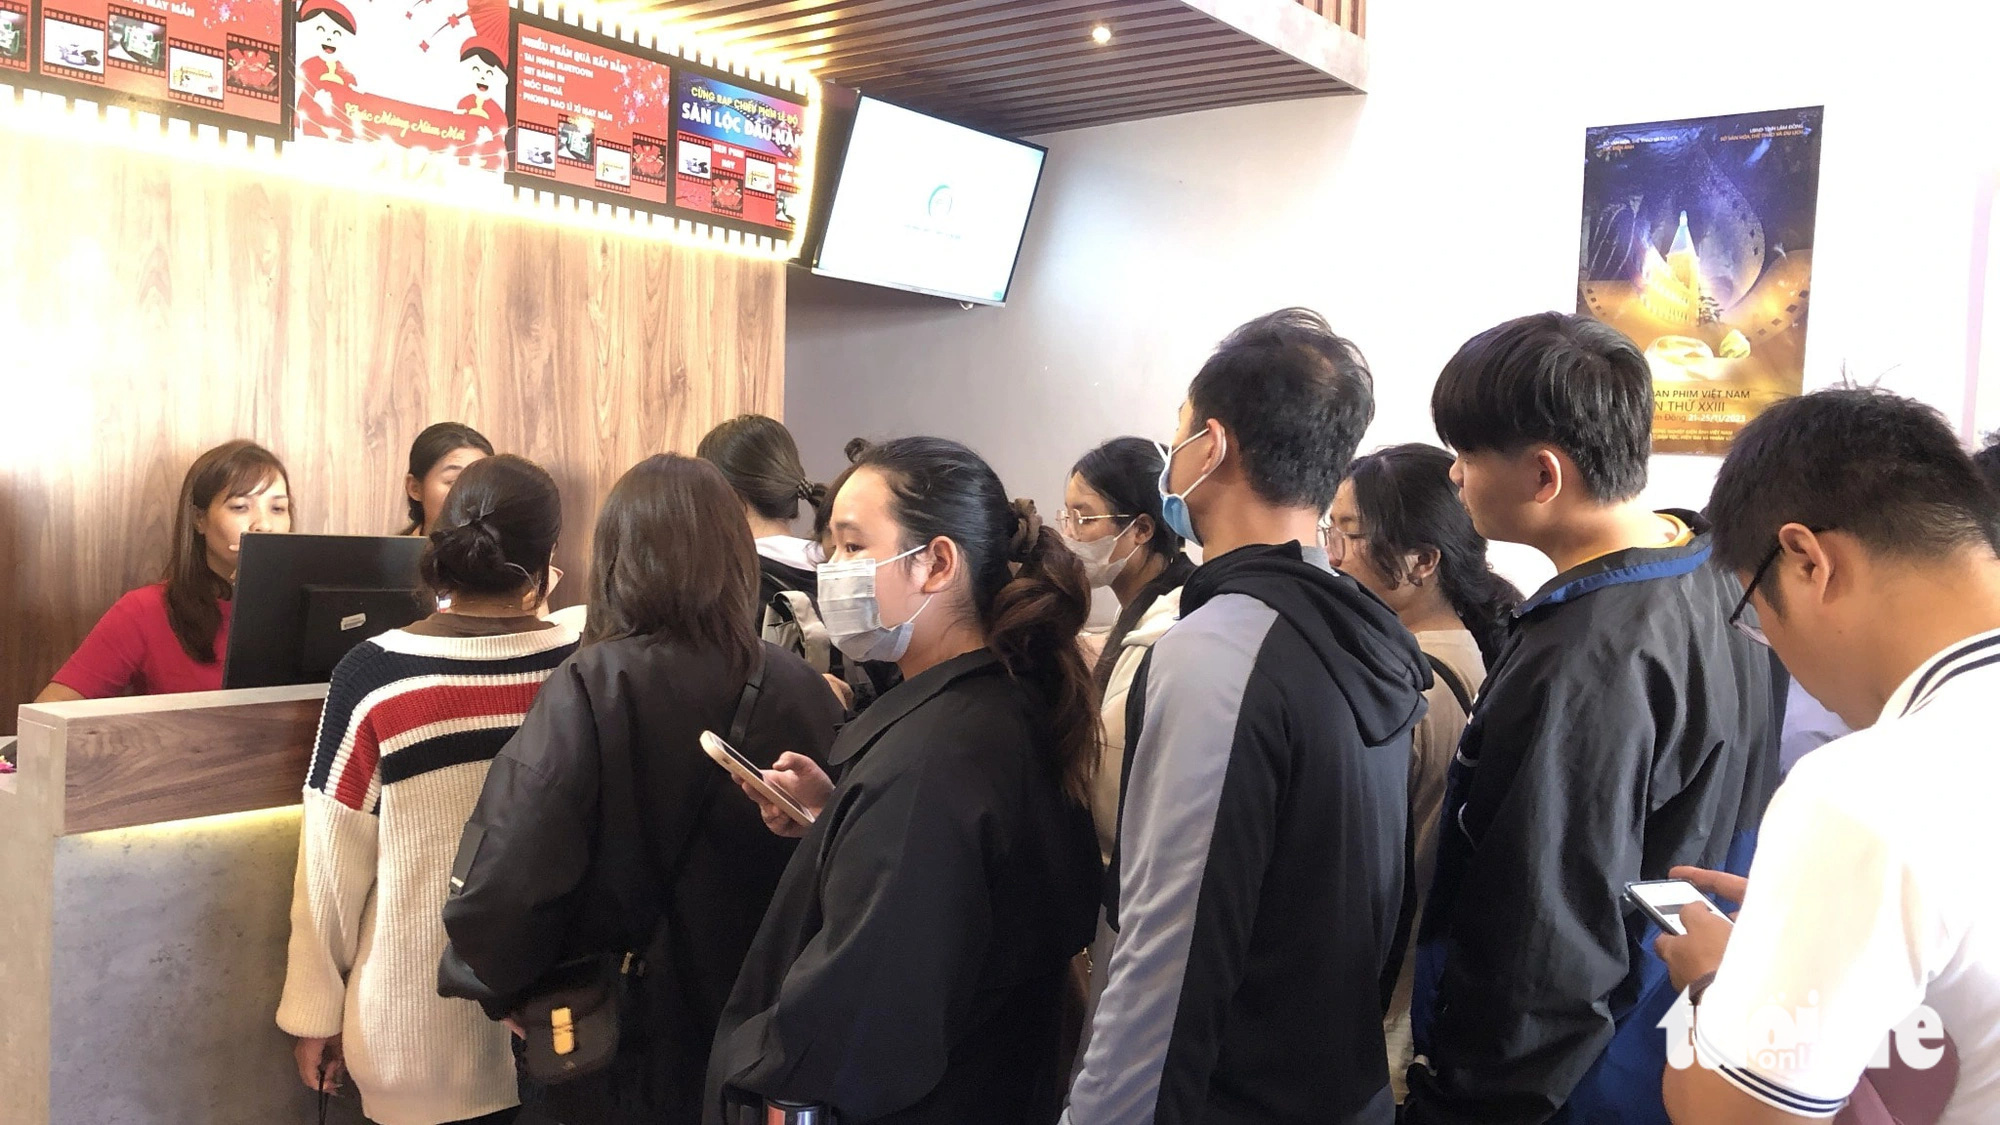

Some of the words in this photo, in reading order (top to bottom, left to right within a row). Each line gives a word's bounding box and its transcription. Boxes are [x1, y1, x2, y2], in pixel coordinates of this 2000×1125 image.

[573, 50, 592, 64] QUÀ
[714, 111, 741, 134] LỘC
[1673, 390, 1698, 398] PHIM
[1701, 388, 1722, 399] VIỆT
[1725, 390, 1750, 399] NAM
[1668, 399, 1695, 412] THỨ
[1697, 401, 1725, 412] XXIII
